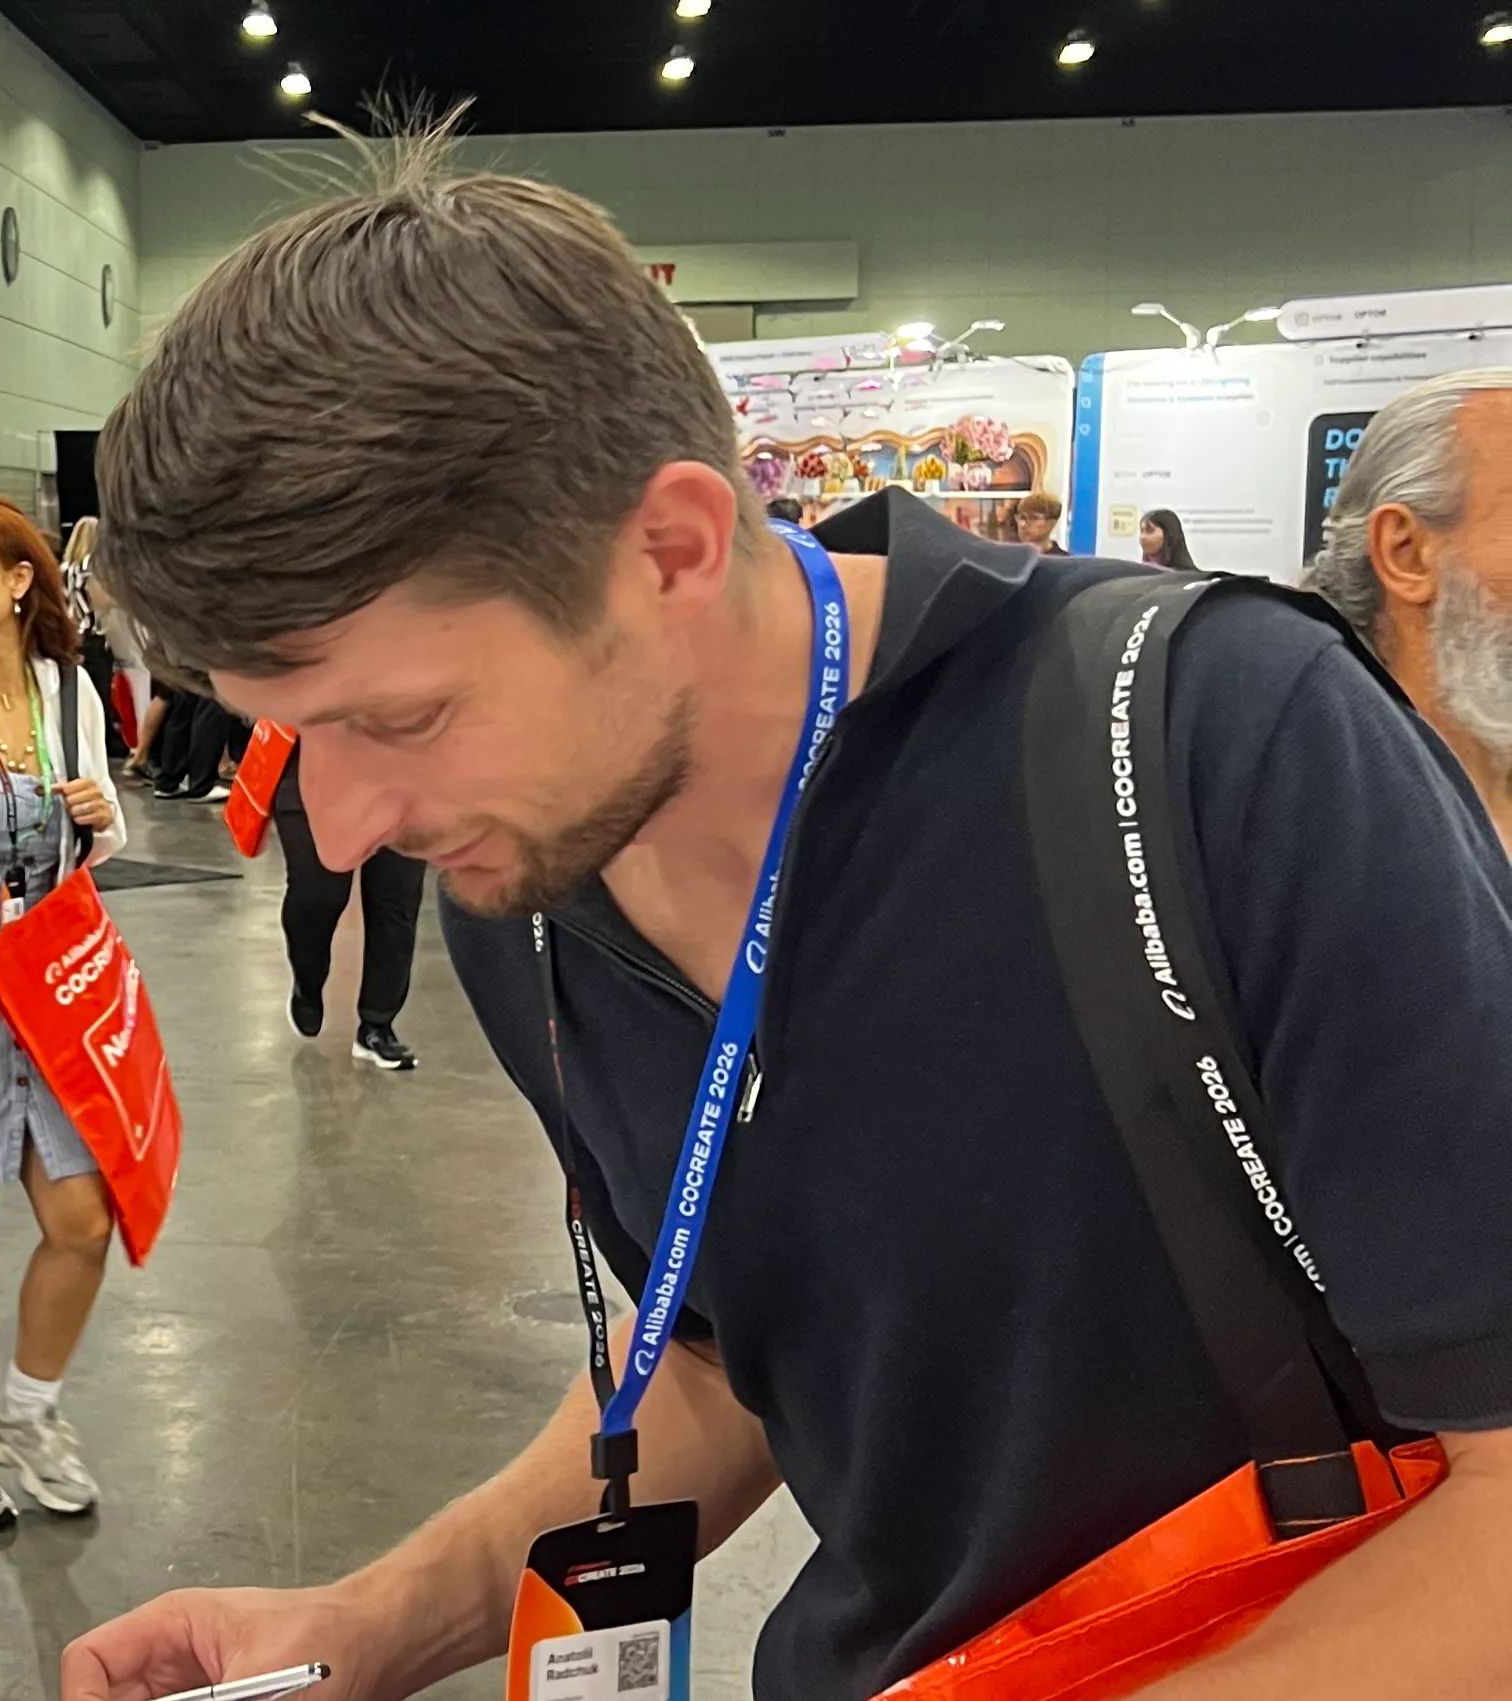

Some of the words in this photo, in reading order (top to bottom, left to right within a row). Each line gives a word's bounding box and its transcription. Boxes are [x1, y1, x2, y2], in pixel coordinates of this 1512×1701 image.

[824, 601, 842, 660] 2026
[1110, 669, 1137, 817] COCREATE
[1121, 832, 1178, 987] Alibaba.com
[1196, 1055, 1237, 1115] 2026
[641, 1227, 691, 1346] Alibaba.com
[679, 1101, 722, 1217] COCREATE
[708, 1041, 738, 1099] 2026
[1222, 1117, 1292, 1236] COCREATE
